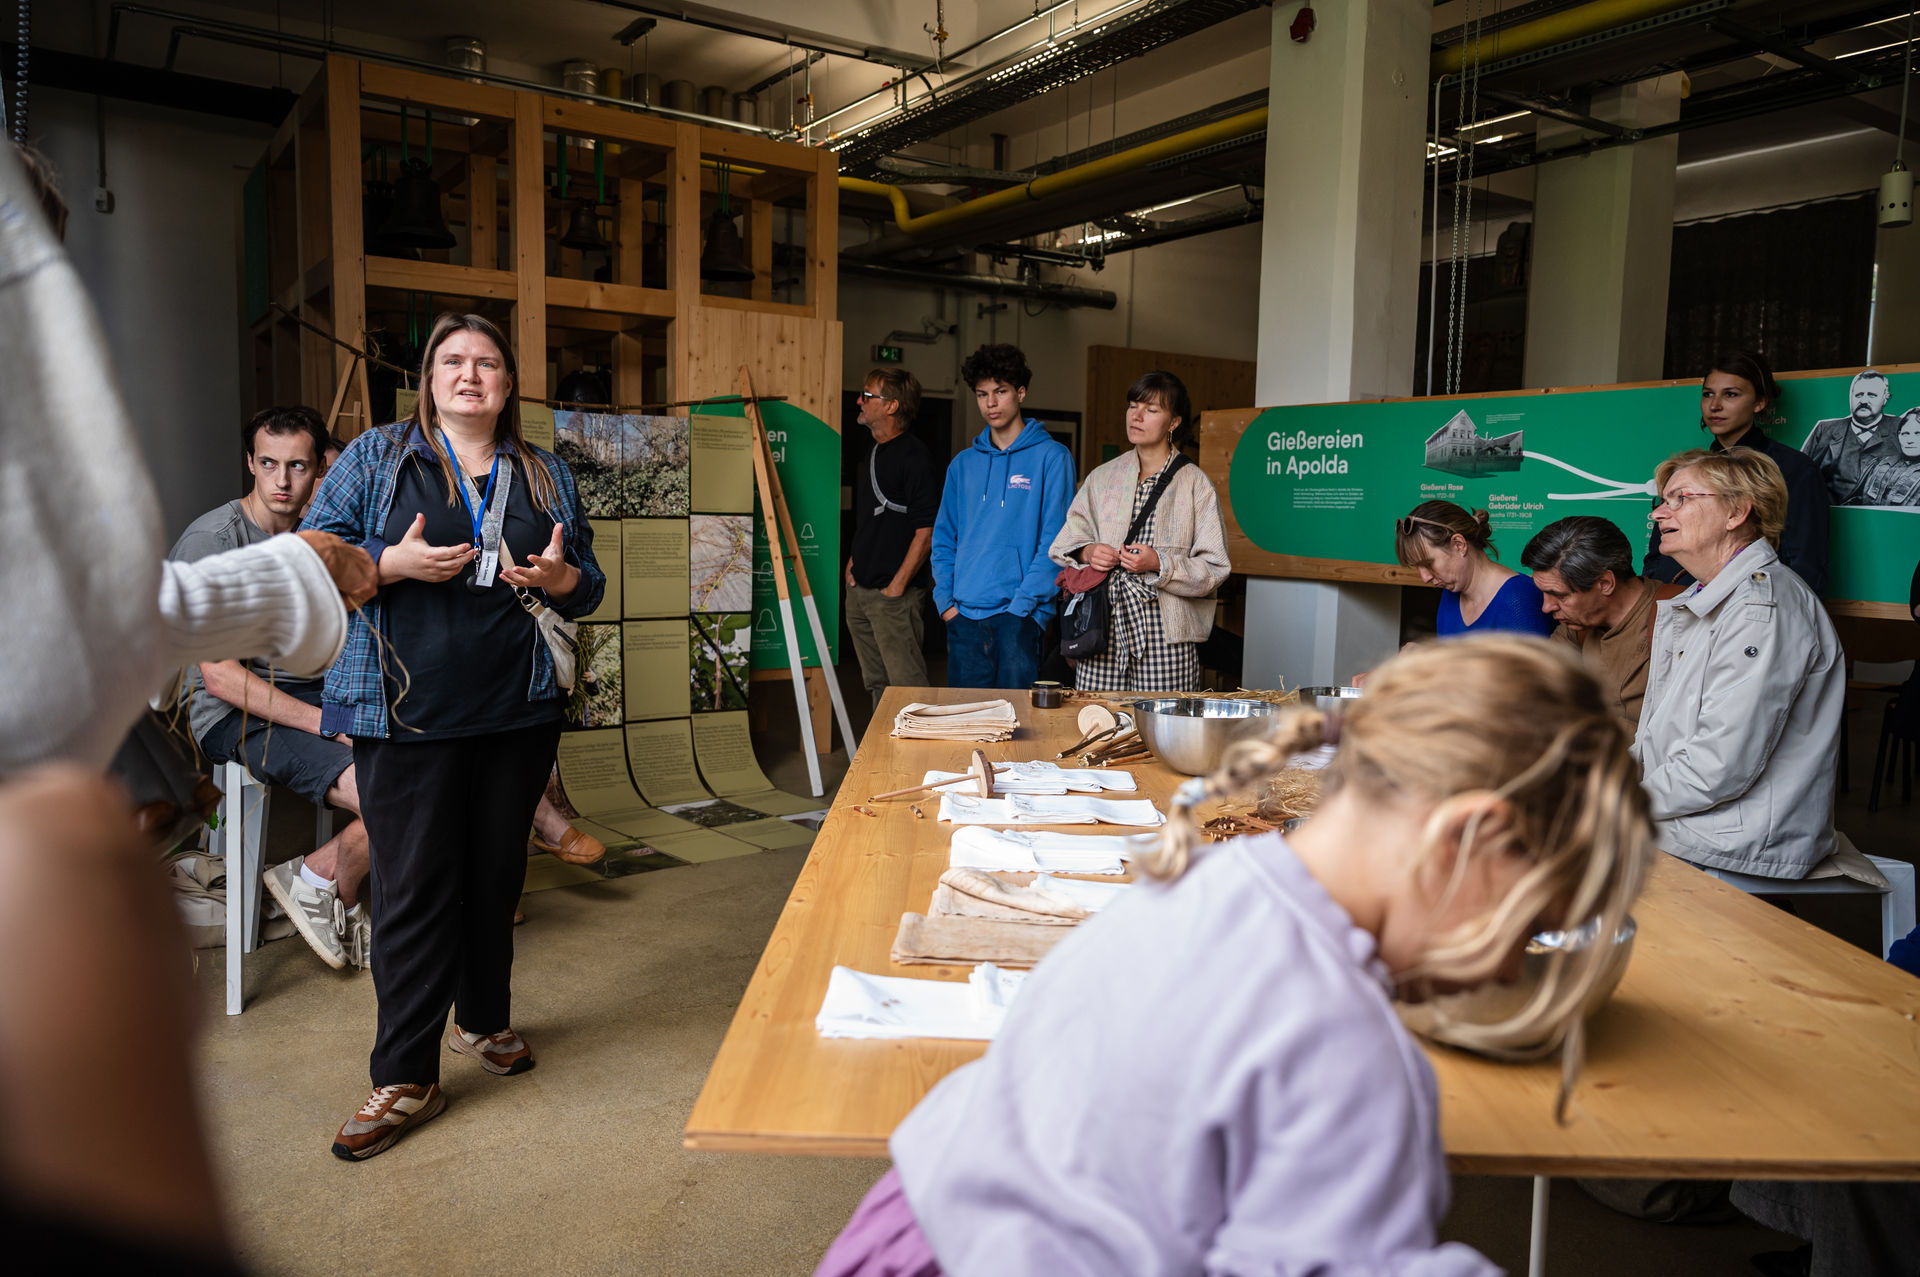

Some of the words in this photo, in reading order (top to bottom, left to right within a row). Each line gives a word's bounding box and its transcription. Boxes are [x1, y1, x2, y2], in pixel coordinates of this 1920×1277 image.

[766, 430, 787, 443] en
[1267, 429, 1364, 451] Gießereien
[1266, 456, 1281, 475] in
[1286, 453, 1349, 480] Apolda
[1420, 483, 1447, 491] Gießerei
[1448, 483, 1463, 491] Rose
[1488, 494, 1518, 502] Gießerei
[1488, 502, 1522, 510] Gebrüder
[1522, 502, 1544, 511] Ulrich
